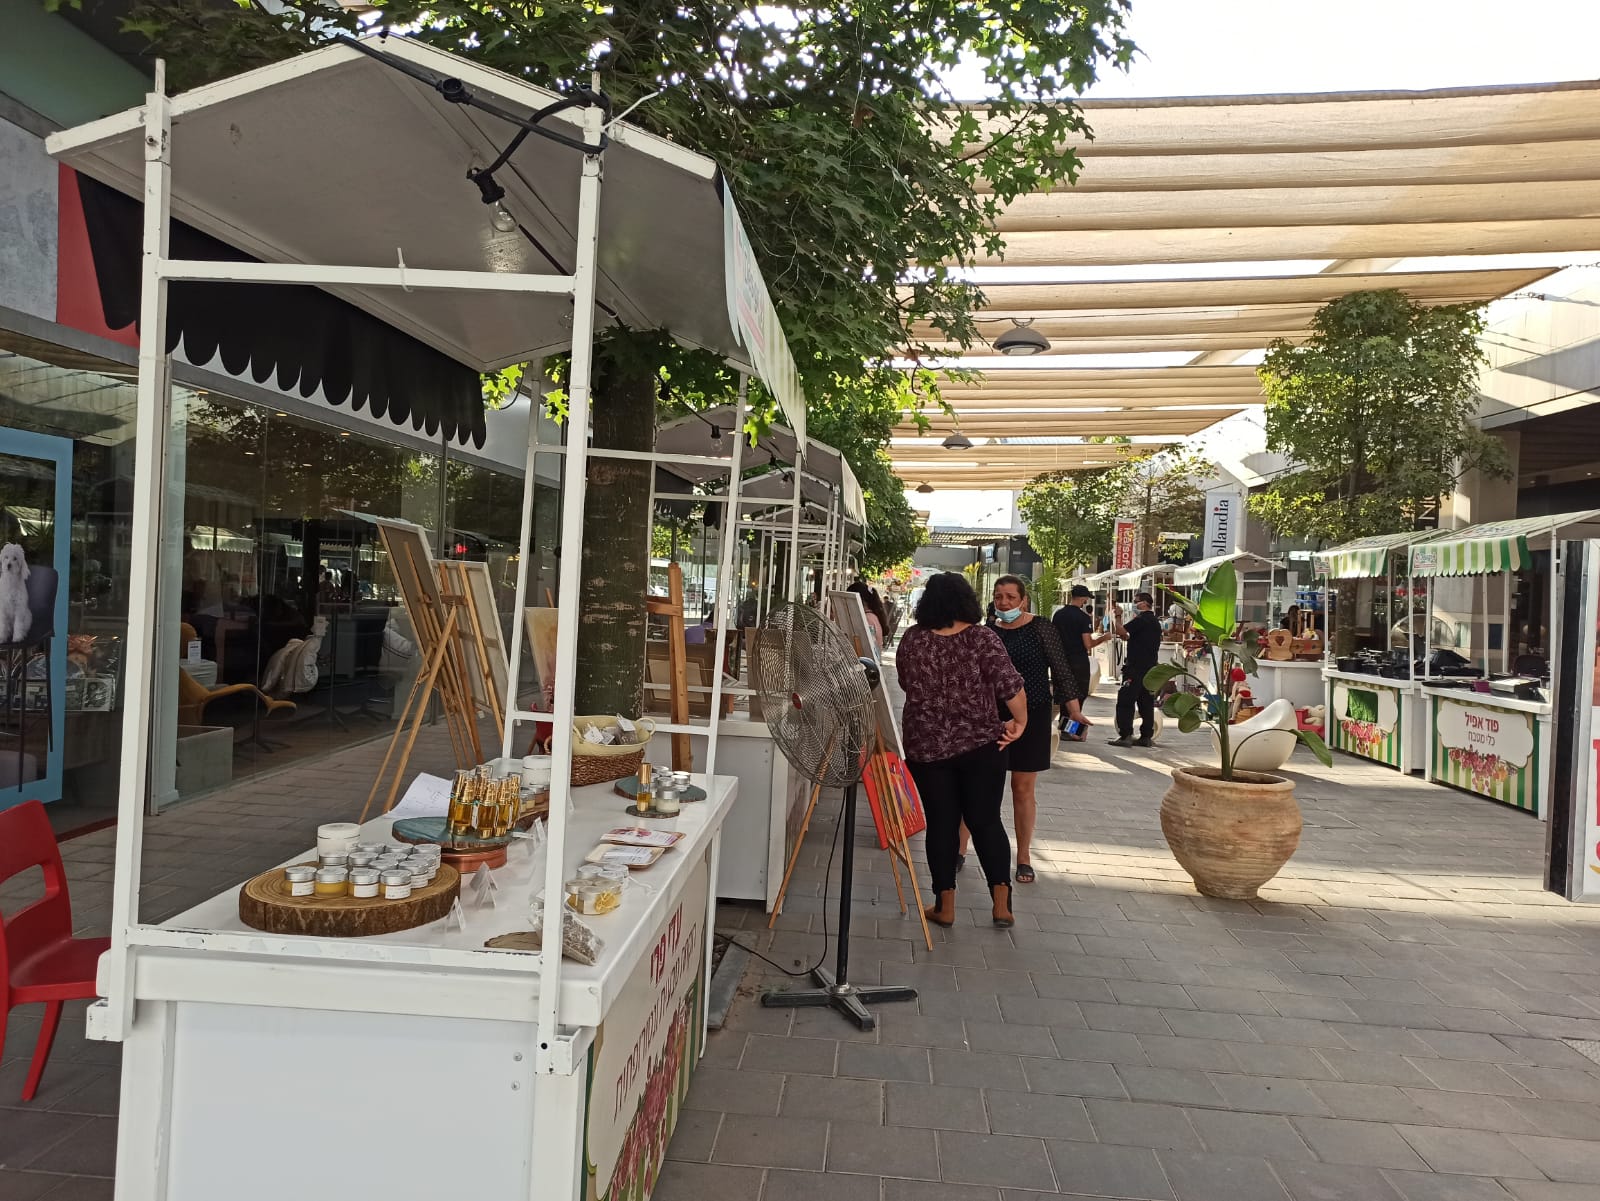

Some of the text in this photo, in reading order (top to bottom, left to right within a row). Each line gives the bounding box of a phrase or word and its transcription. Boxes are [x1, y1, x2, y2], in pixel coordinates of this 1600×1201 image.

[1211, 499, 1229, 557] ollandia
[1464, 711, 1500, 733] פוד אפיל
[1468, 730, 1496, 746] כלי מטבח
[649, 901, 683, 985] עדי פרי
[658, 956, 680, 1024] טבעית
